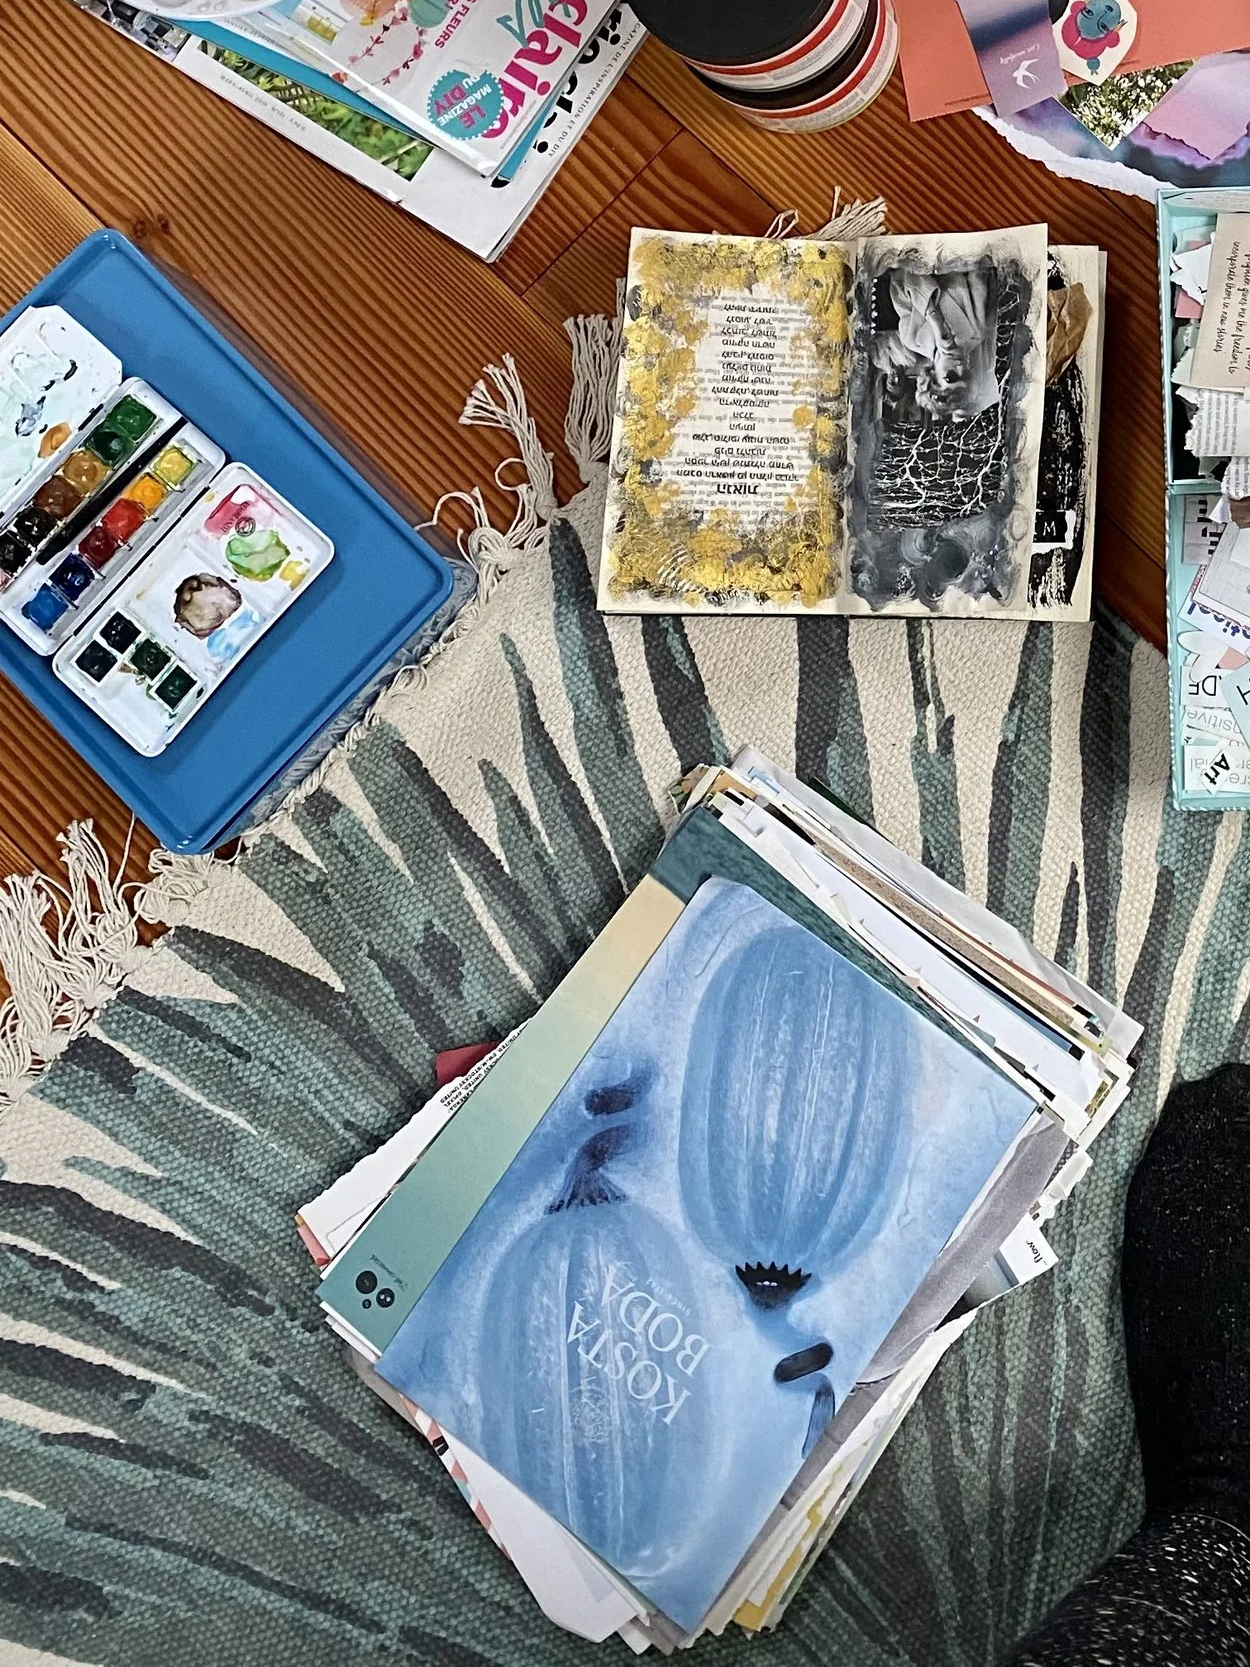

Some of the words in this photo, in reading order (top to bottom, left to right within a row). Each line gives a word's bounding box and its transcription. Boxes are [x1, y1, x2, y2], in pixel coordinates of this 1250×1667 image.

[433, 0, 470, 52] FLEURS
[432, 83, 496, 125] MAGAZINE
[456, 103, 488, 130] LE
[556, 129, 569, 144] DU
[1224, 241, 1241, 281] incorporate
[1223, 282, 1235, 301] them
[1219, 311, 1228, 326] new
[1228, 333, 1244, 363] freedom
[733, 410, 753, 418] הכלב
[729, 421, 755, 430] העיתון
[735, 447, 765, 455] נלהבות
[684, 456, 708, 465] הספר
[711, 456, 729, 466] הישן
[732, 458, 765, 467] שנתגלה
[768, 460, 793, 468] מחדש
[737, 470, 747, 479] מן
[748, 470, 772, 480] החלון
[715, 483, 758, 495] הנאות
[1204, 753, 1231, 785] Art
[1023, 1240, 1043, 1264] flow
[585, 1260, 716, 1379] BODA
[550, 1297, 695, 1428] KOSTA
